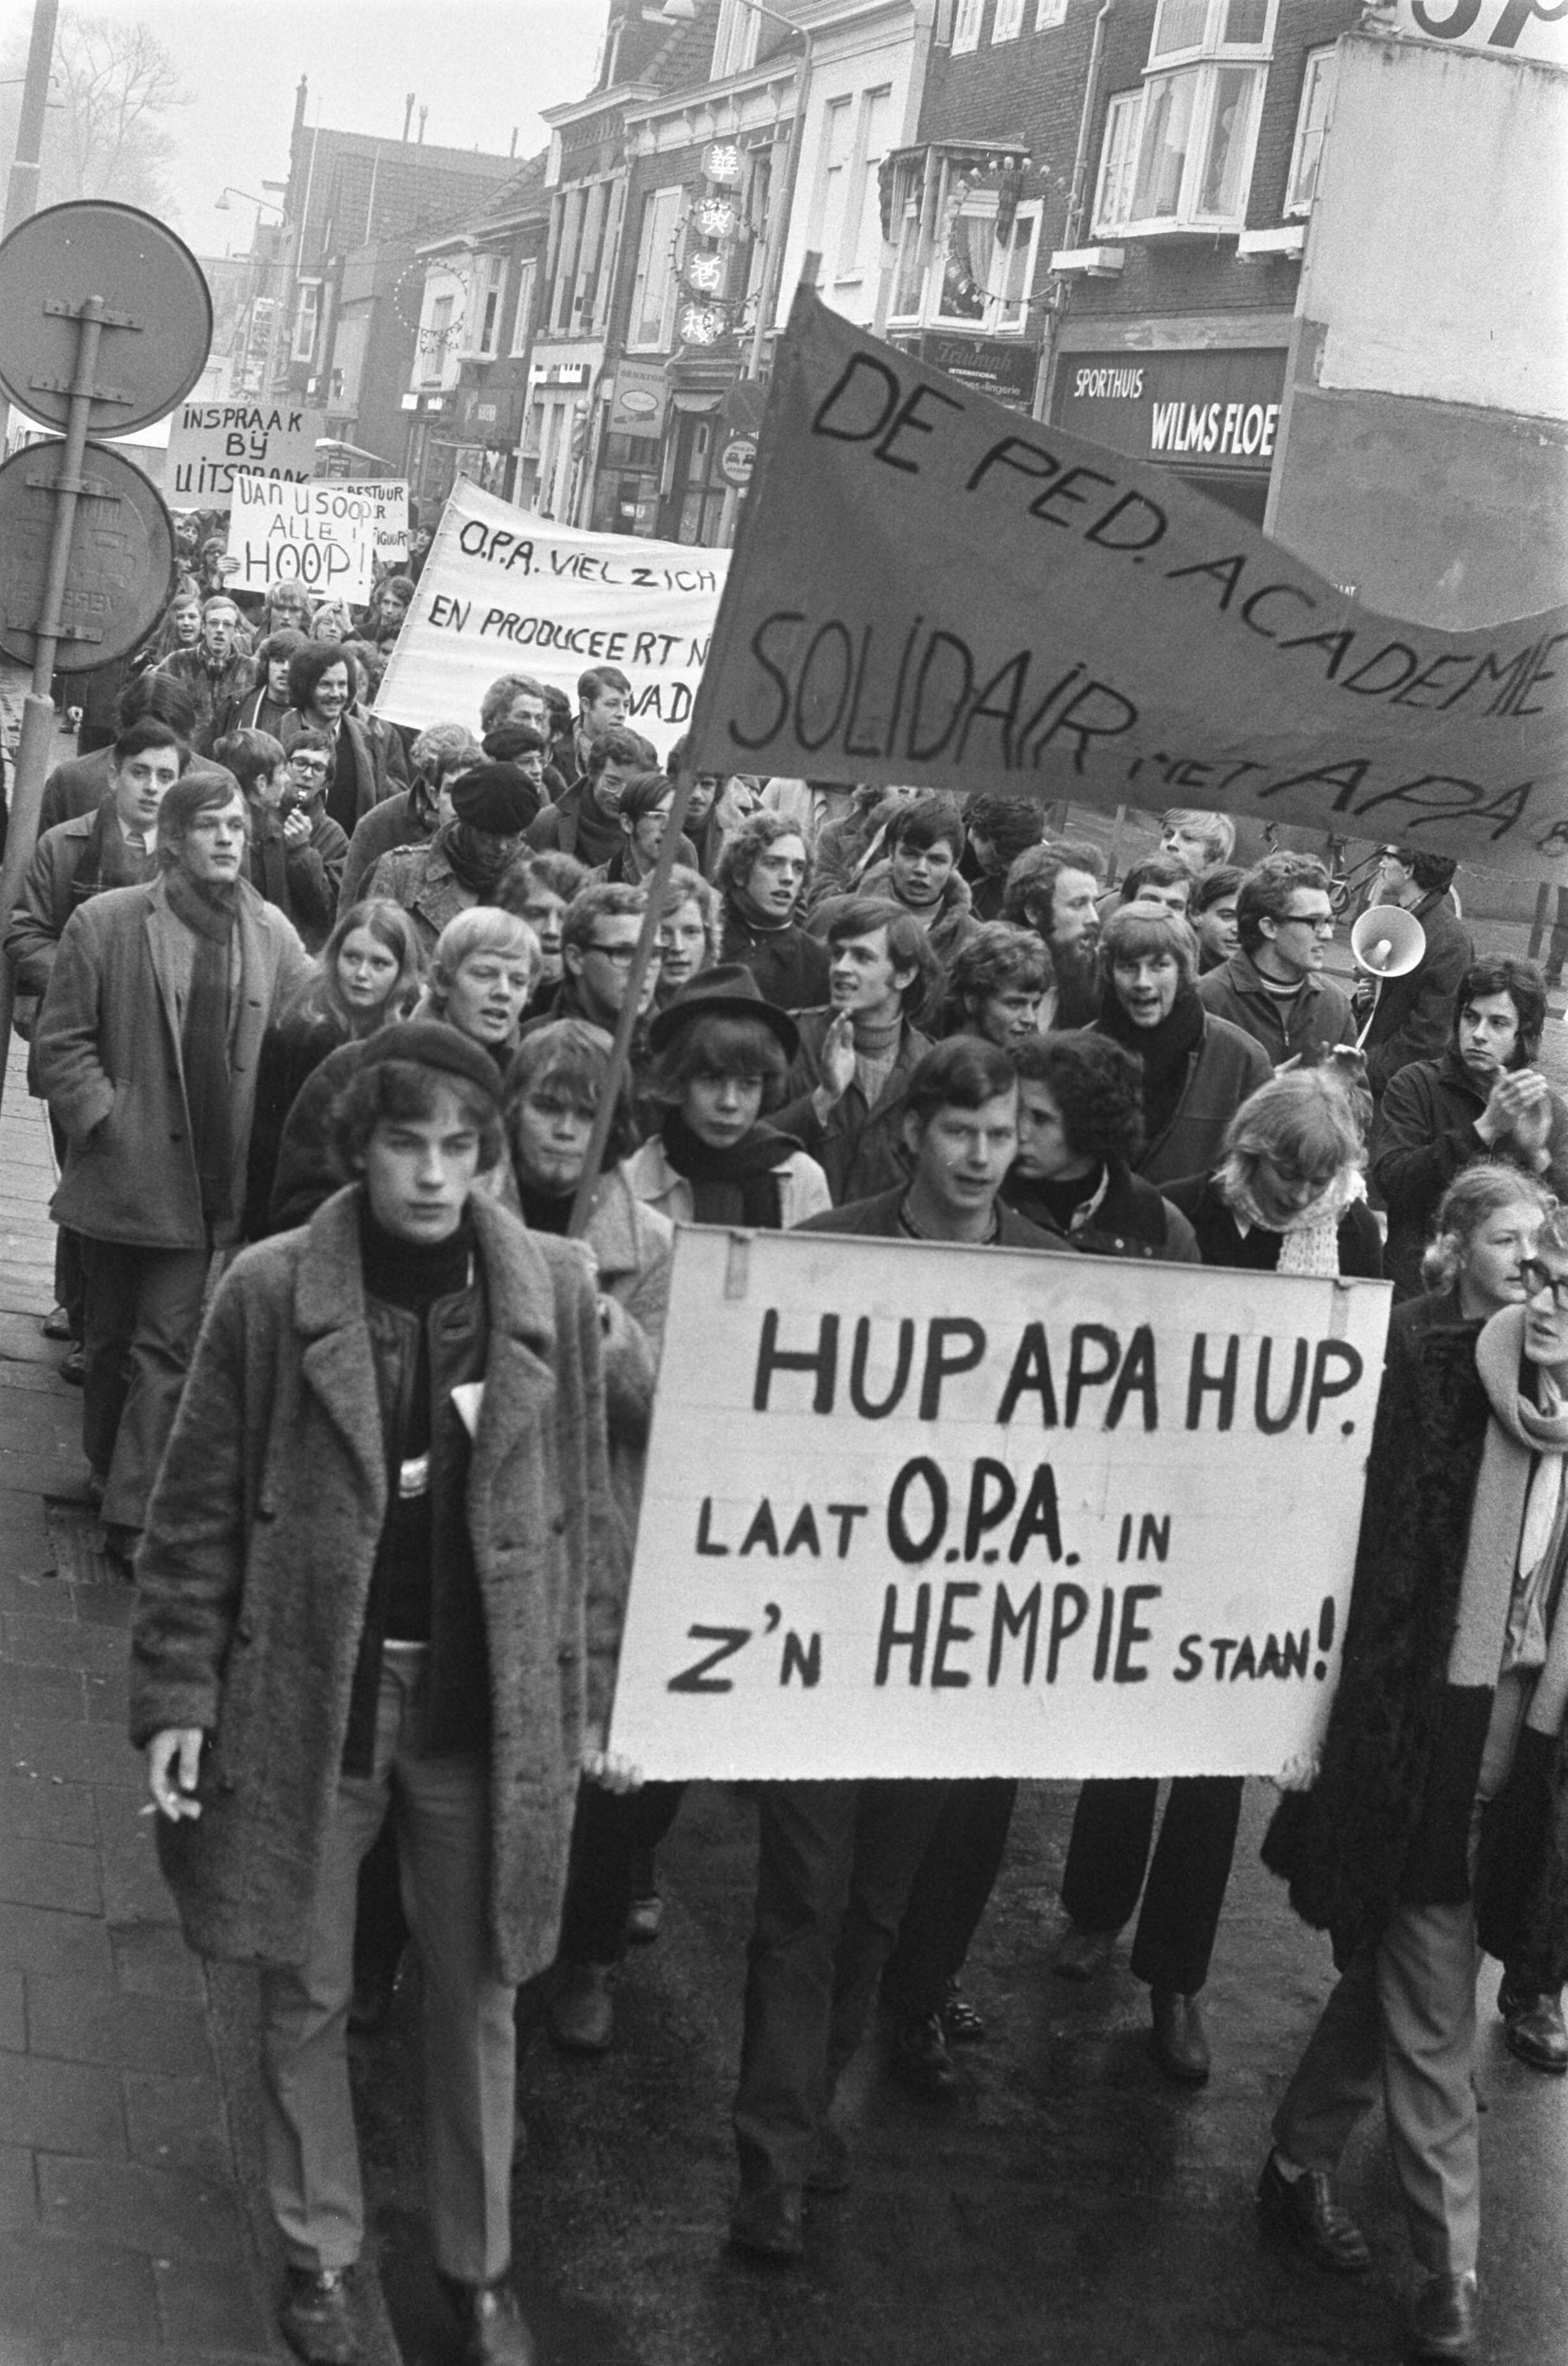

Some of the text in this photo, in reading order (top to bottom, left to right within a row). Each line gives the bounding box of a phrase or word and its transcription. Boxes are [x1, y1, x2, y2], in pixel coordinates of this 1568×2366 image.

[1074, 368, 1144, 399] SPORTHUIS
[1151, 402, 1283, 455] WILMS FLOE
[459, 520, 716, 592] O.P.A. VIEL ZICH
[812, 352, 1568, 717] DE PED. ACADEMIE
[428, 594, 471, 632] EN
[480, 608, 684, 665] PRODUCEERT
[729, 611, 1139, 775] SOLIDAIR
[753, 1307, 1365, 1436] HUP APA HUP.
[695, 1457, 1172, 1566] LAAT O.P.A. IN
[874, 1582, 1163, 1688] HEMPIE
[1172, 1595, 1337, 1681] STAAN!
